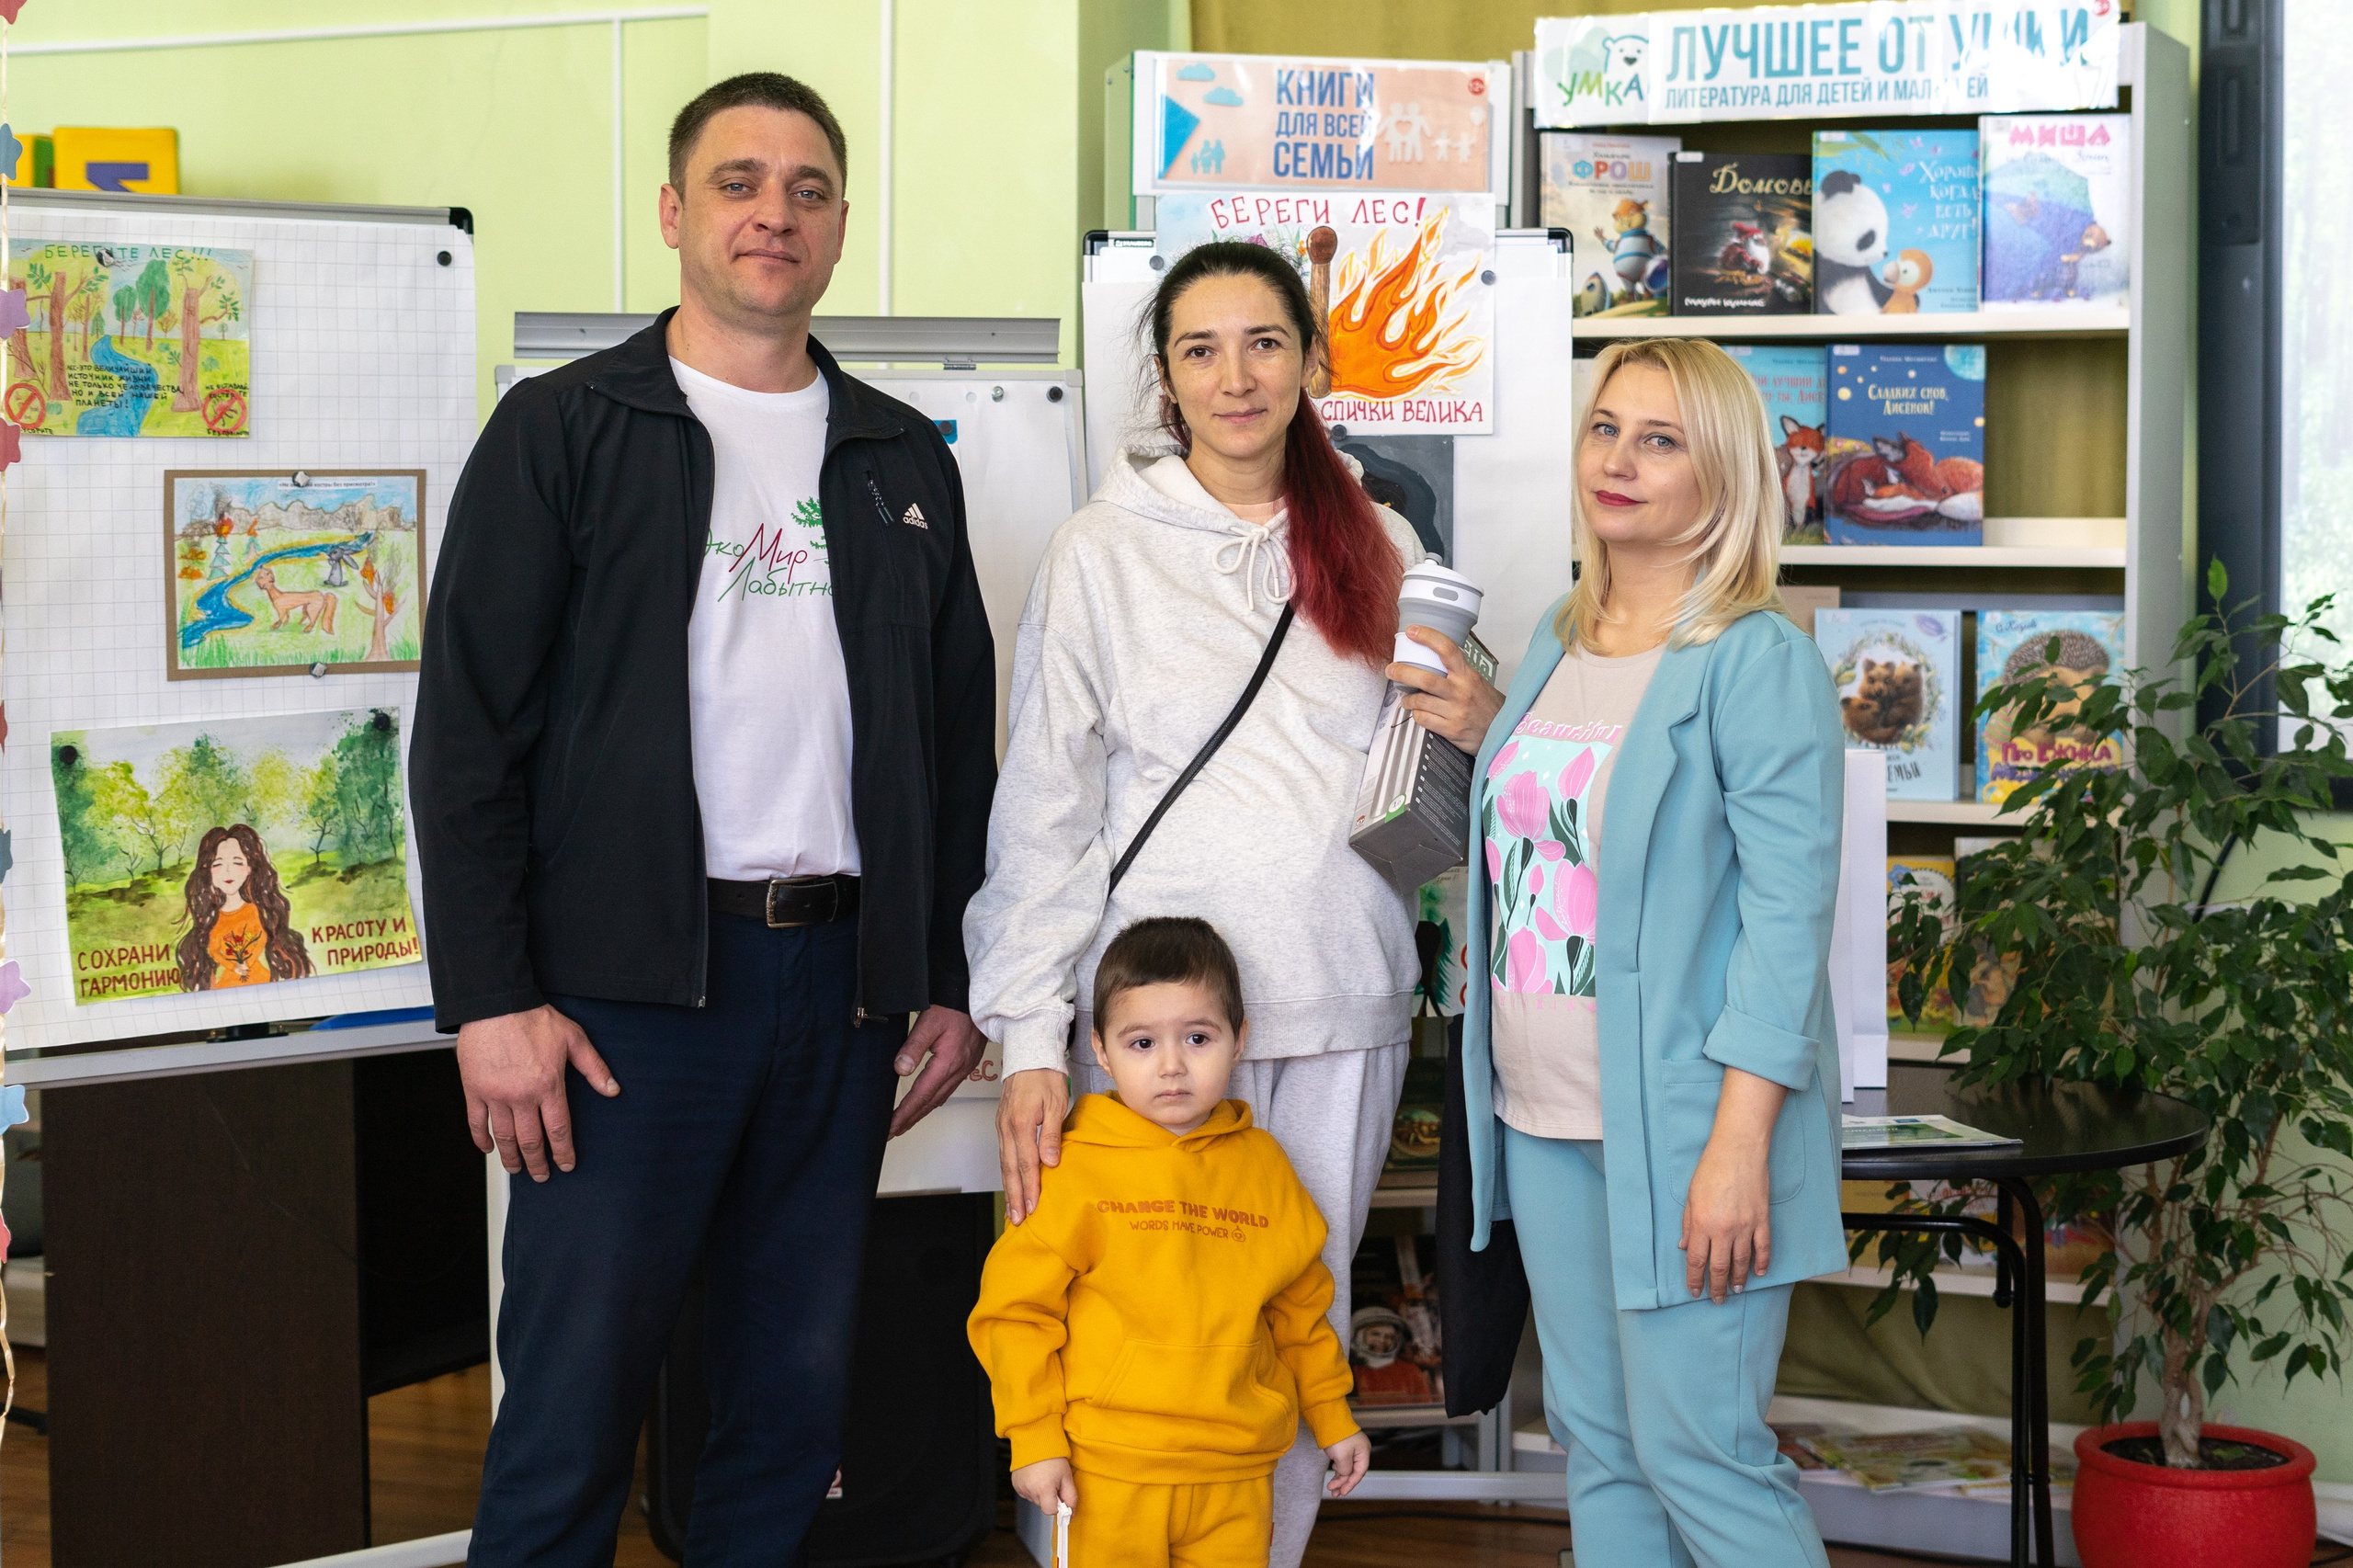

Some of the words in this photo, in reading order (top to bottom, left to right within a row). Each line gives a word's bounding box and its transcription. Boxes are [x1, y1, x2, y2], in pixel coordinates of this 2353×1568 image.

[1665, 18, 1862, 82] ЛУЧШЕЕ
[1878, 15, 1935, 74] ОТ
[1276, 69, 1374, 108] КНИГИ
[1556, 70, 1644, 107] УМКА
[1665, 84, 1772, 109] ЛИТЕРАТУРА
[1775, 82, 1813, 108] ДЛЯ
[1816, 76, 1872, 106] ДЕТЕЙ
[1877, 80, 1889, 101] И
[1893, 74, 1989, 101] МАЛЕЙ
[1275, 111, 1318, 138] ДЛЯ
[2008, 123, 2111, 148] МИША
[1273, 141, 1374, 181] СЕМЬИ
[1573, 160, 1651, 181] ФРОШ
[1211, 196, 1330, 229] БЕРЕГИ
[67, 372, 115, 381] ИСТОЧНИК
[83, 381, 115, 390] ТОЛЬКО
[1321, 400, 1395, 422] СПИЧКИ
[1401, 400, 1483, 424] ВЕЛИКА
[903, 517, 928, 529] adidas
[1887, 761, 1921, 783] ЕМЬИ
[311, 920, 388, 944] КРАСОТУ
[392, 916, 407, 935] И
[77, 943, 172, 971] СОХРАНИ
[326, 937, 418, 966] ПРИРОДЫ!
[80, 968, 181, 997] ГАРМОНИЮ
[1097, 1199, 1176, 1214] CHANGE
[1178, 1200, 1209, 1219] THE
[1211, 1206, 1269, 1229] WORLD
[1130, 1220, 1169, 1232] WORDS
[1172, 1221, 1196, 1233] HAVE
[1197, 1225, 1229, 1239] POWER
